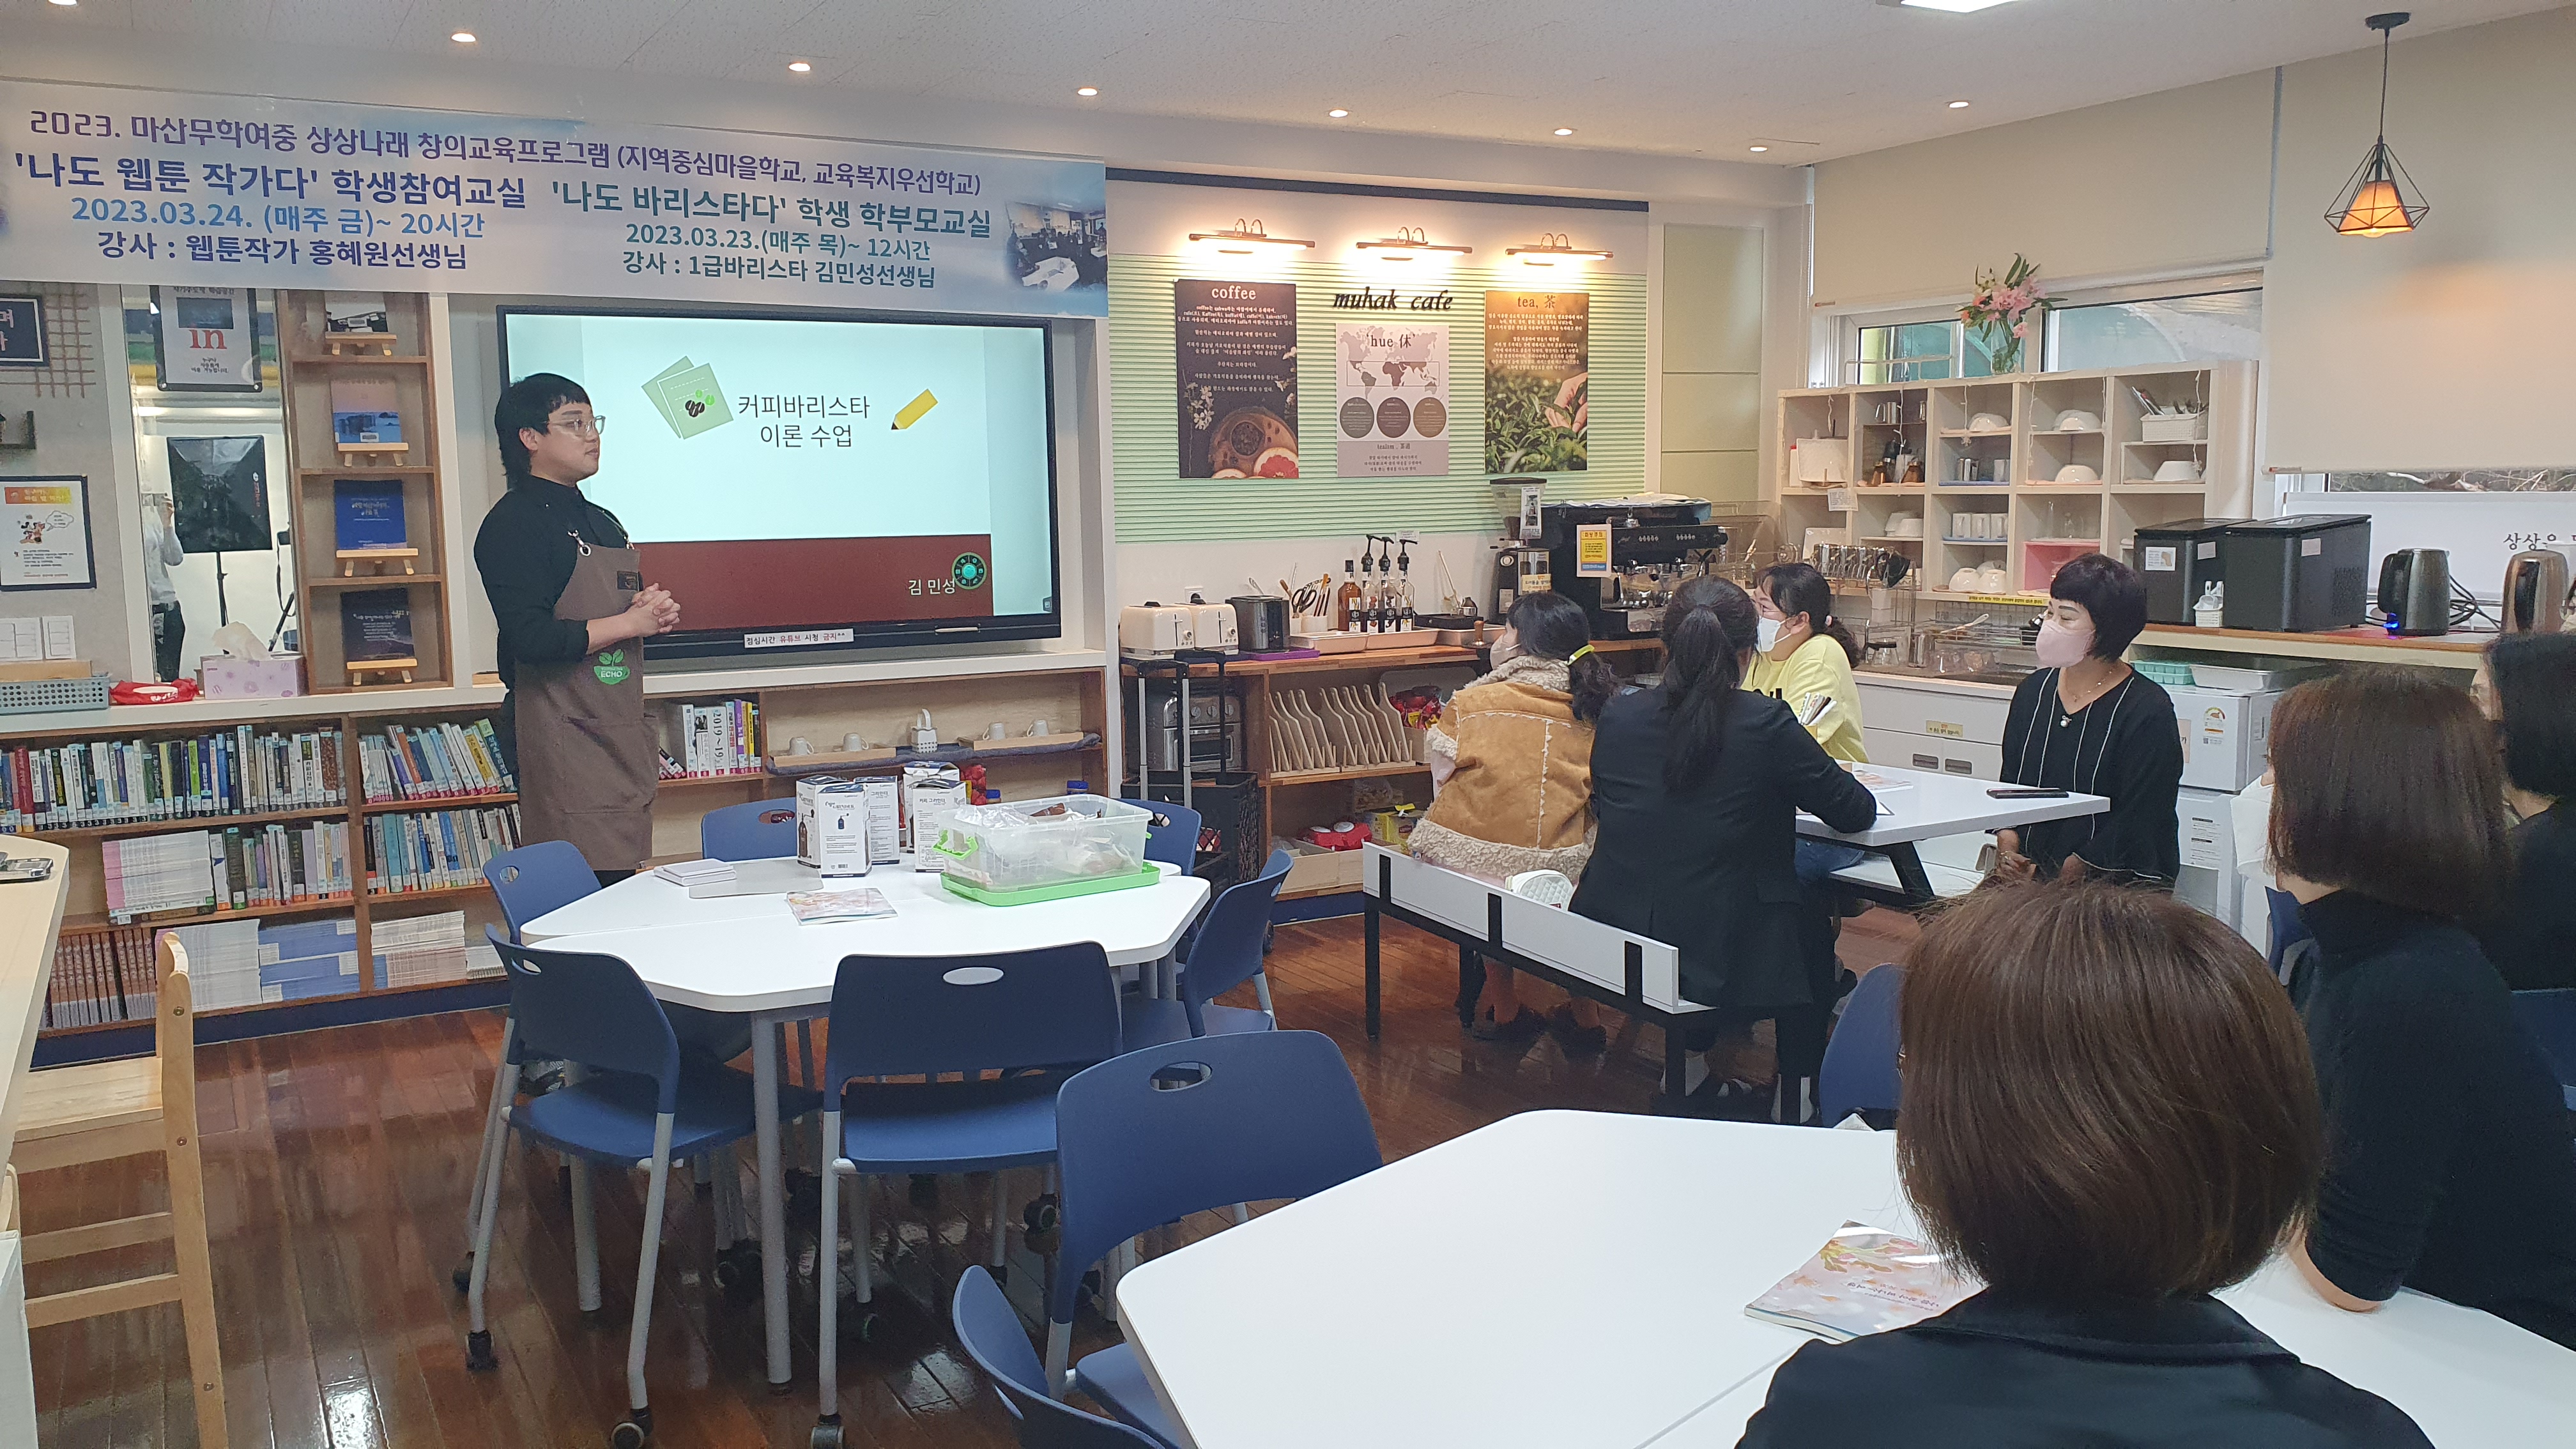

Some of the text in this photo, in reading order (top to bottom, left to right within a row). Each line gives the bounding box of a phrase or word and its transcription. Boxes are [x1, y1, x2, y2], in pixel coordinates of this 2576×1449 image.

[30, 111, 981, 197] 2023. 마산무학여중 상상나래 창의교육프로그램 (지역중심마을학교, 교육복지우선학교)
[15, 153, 526, 210] '나도 웹툰 작가다' 학생참여교실
[71, 196, 253, 229] 2023.03.24.
[263, 205, 330, 235] (매주
[399, 212, 486, 240] 20시간
[552, 180, 992, 239] '나도 바리스타다' 학생 학부모교실
[97, 231, 158, 260] 강사
[185, 236, 300, 266] 웹툰작가
[309, 239, 467, 271] 홍혜원선생님
[867, 237, 931, 263] 12시간
[622, 250, 668, 276] 강사
[689, 256, 808, 284] 1급바리스타
[815, 261, 936, 289] 김민성선생님
[1211, 285, 1257, 300] coffee
[1333, 286, 1453, 310] muhak cafe
[1517, 295, 1556, 309] tea, 茶
[738, 394, 870, 419] 커피바리스타
[760, 424, 853, 448] 이론 수업
[908, 577, 956, 596] 김 민성
[779, 635, 801, 643] 유튜브
